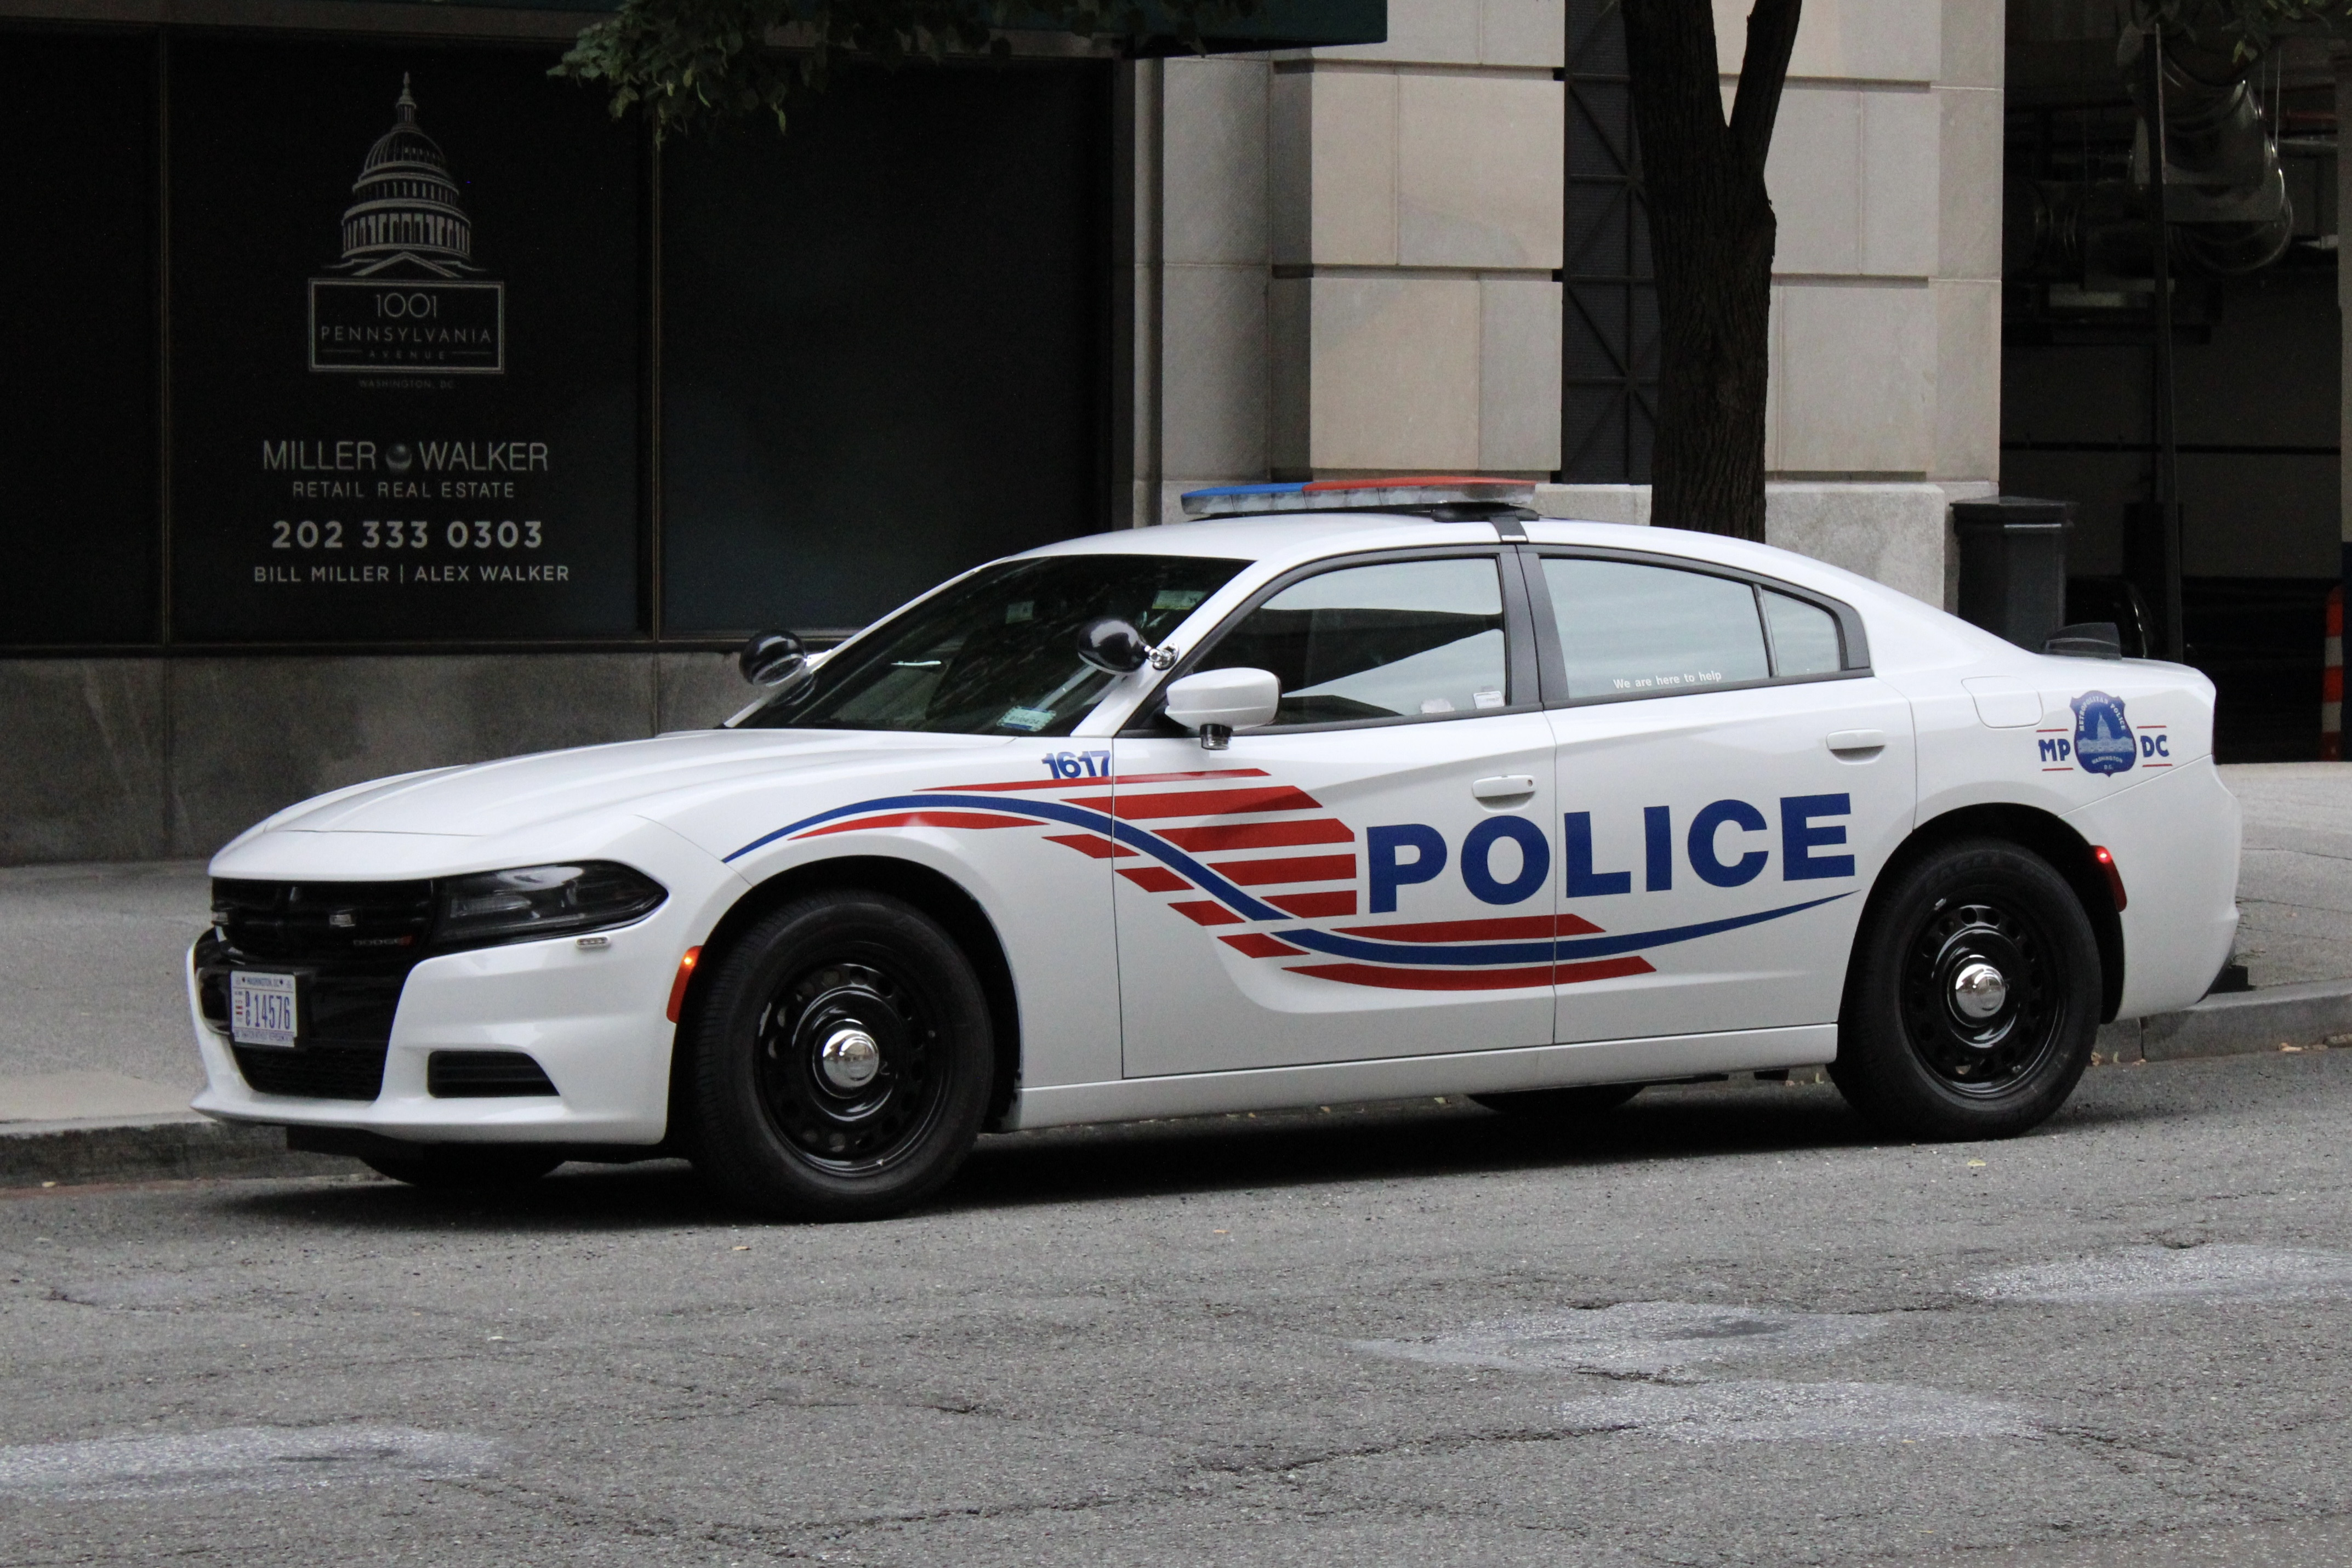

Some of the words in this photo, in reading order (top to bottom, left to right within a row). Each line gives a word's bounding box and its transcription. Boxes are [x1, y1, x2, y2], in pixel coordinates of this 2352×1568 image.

[376, 293, 436, 318] 1001
[321, 326, 492, 344] PENNSYLVANIA
[369, 350, 445, 360] AVENUE
[263, 440, 376, 471] MILLER
[418, 441, 549, 472] WALKER
[293, 481, 365, 498] RETAIL
[378, 482, 431, 498] REAL
[442, 482, 515, 498] ESTATE
[272, 521, 343, 549] 202
[362, 521, 428, 549] 333
[447, 521, 543, 549] 0303
[254, 566, 301, 583] BILL
[311, 566, 390, 583] MILLER
[414, 566, 470, 582] ALEX
[479, 566, 570, 582] WALKER
[1612, 677, 1631, 689] We
[1635, 678, 1652, 687] are
[1655, 674, 1680, 686] here
[1684, 673, 1695, 683] to
[1698, 669, 1722, 683] help
[2110, 703, 2126, 731] POLICE
[2038, 738, 2071, 761] MP
[2140, 734, 2169, 757] DC
[1041, 750, 1111, 779] 1617
[2091, 756, 2123, 765] WASHINGTON
[1366, 792, 1856, 914] POLICE
[255, 993, 291, 1030] 14576
